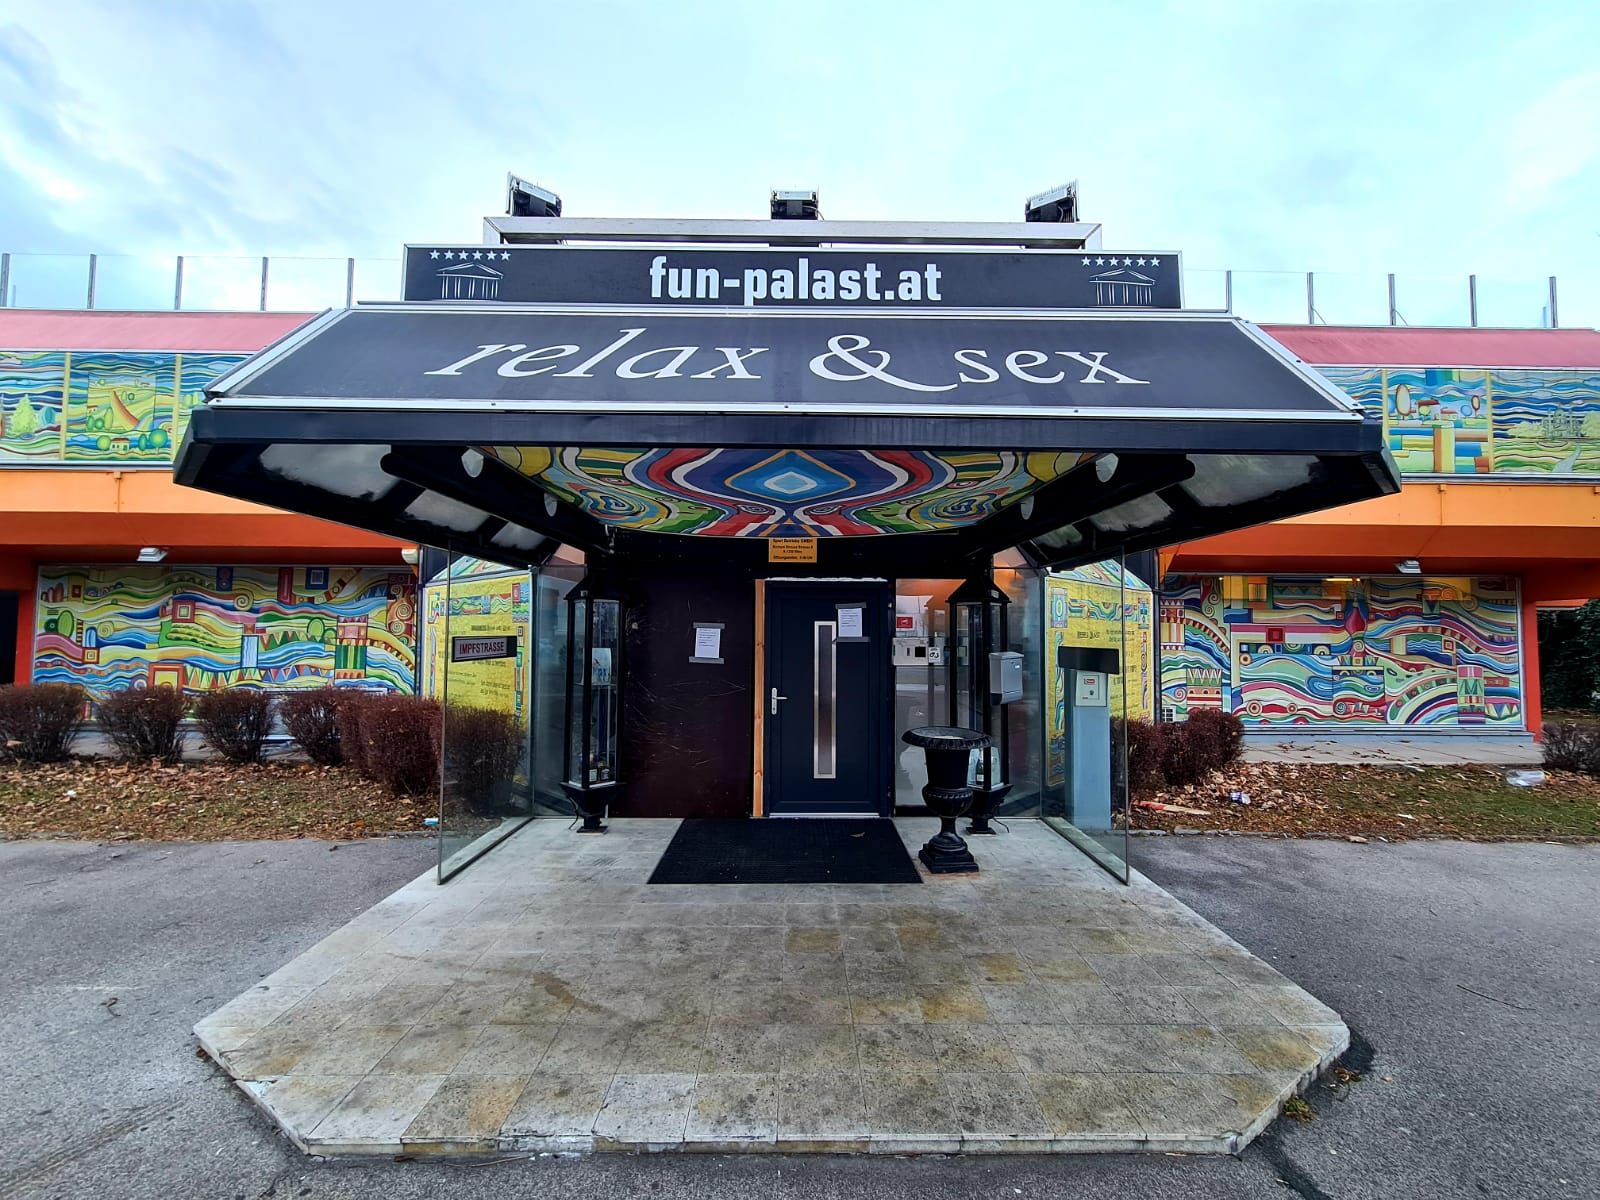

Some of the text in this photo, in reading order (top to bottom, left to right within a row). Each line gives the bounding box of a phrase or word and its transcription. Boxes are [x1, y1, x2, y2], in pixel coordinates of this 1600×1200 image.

[649, 255, 942, 304] fun-palast.at
[424, 328, 1151, 392] relax & sex
[459, 641, 505, 655] IMPFSTRASSE
